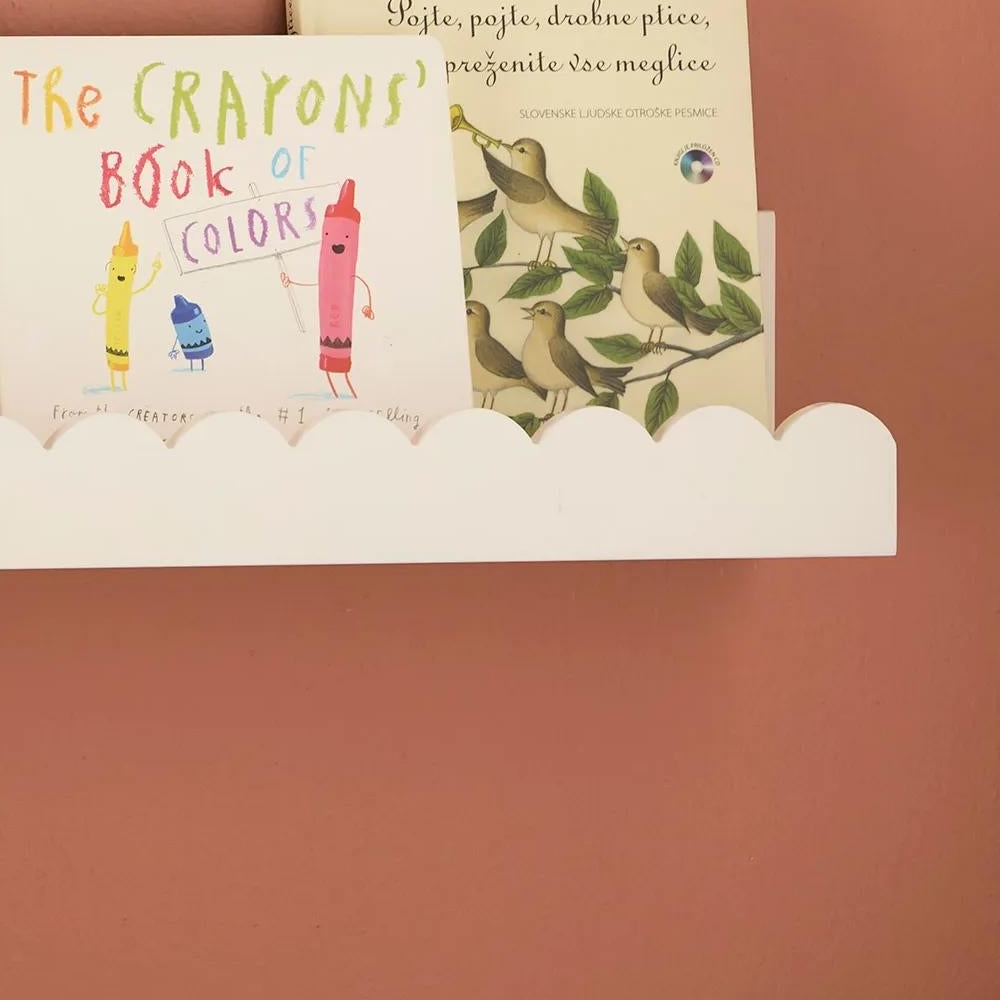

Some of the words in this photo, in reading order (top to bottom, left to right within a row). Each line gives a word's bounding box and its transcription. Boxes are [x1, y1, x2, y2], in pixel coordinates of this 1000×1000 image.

[470, 4, 540, 40] pojte,
[642, 4, 710, 36] ptice,
[445, 50, 563, 87] preženite
[568, 52, 611, 73] vse
[615, 43, 717, 86] meglice
[13, 64, 103, 133] The
[133, 59, 426, 145] CRAYONS'
[519, 108, 577, 119] SLOVENSKE
[579, 108, 624, 119] LJUDSKE
[625, 106, 672, 119] OTROŠKE
[675, 107, 718, 118] PESMICE
[270, 145, 316, 181] OF
[181, 197, 317, 264] COLORS
